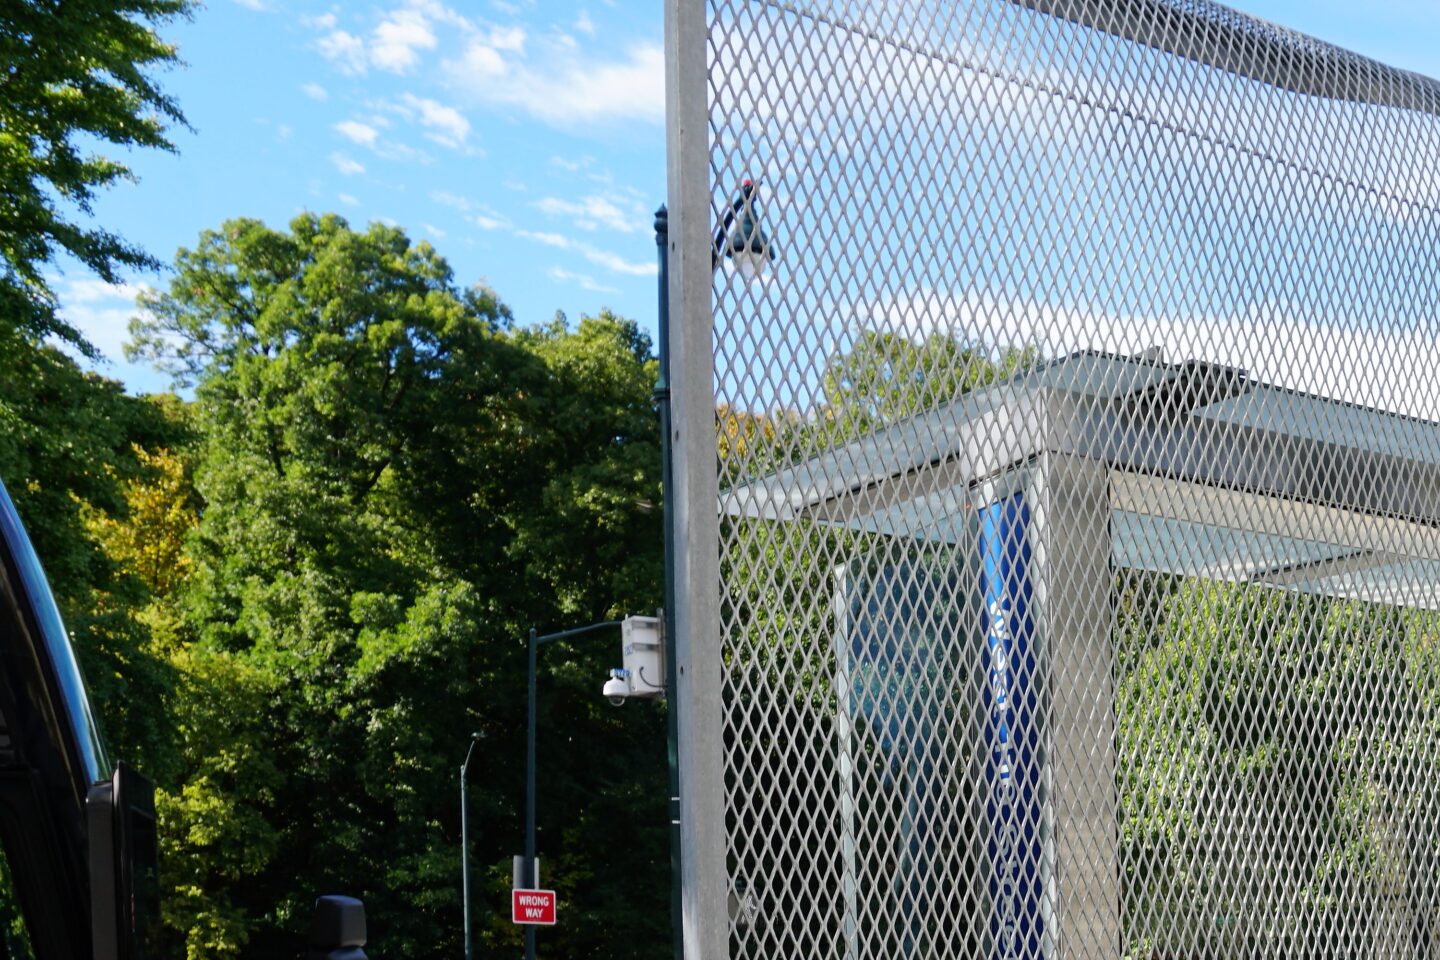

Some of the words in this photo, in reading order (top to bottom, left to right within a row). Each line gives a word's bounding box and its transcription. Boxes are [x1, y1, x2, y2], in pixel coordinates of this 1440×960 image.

[990, 592, 1011, 714] West
[519, 895, 550, 907] WRONG
[525, 908, 543, 918] WAY
